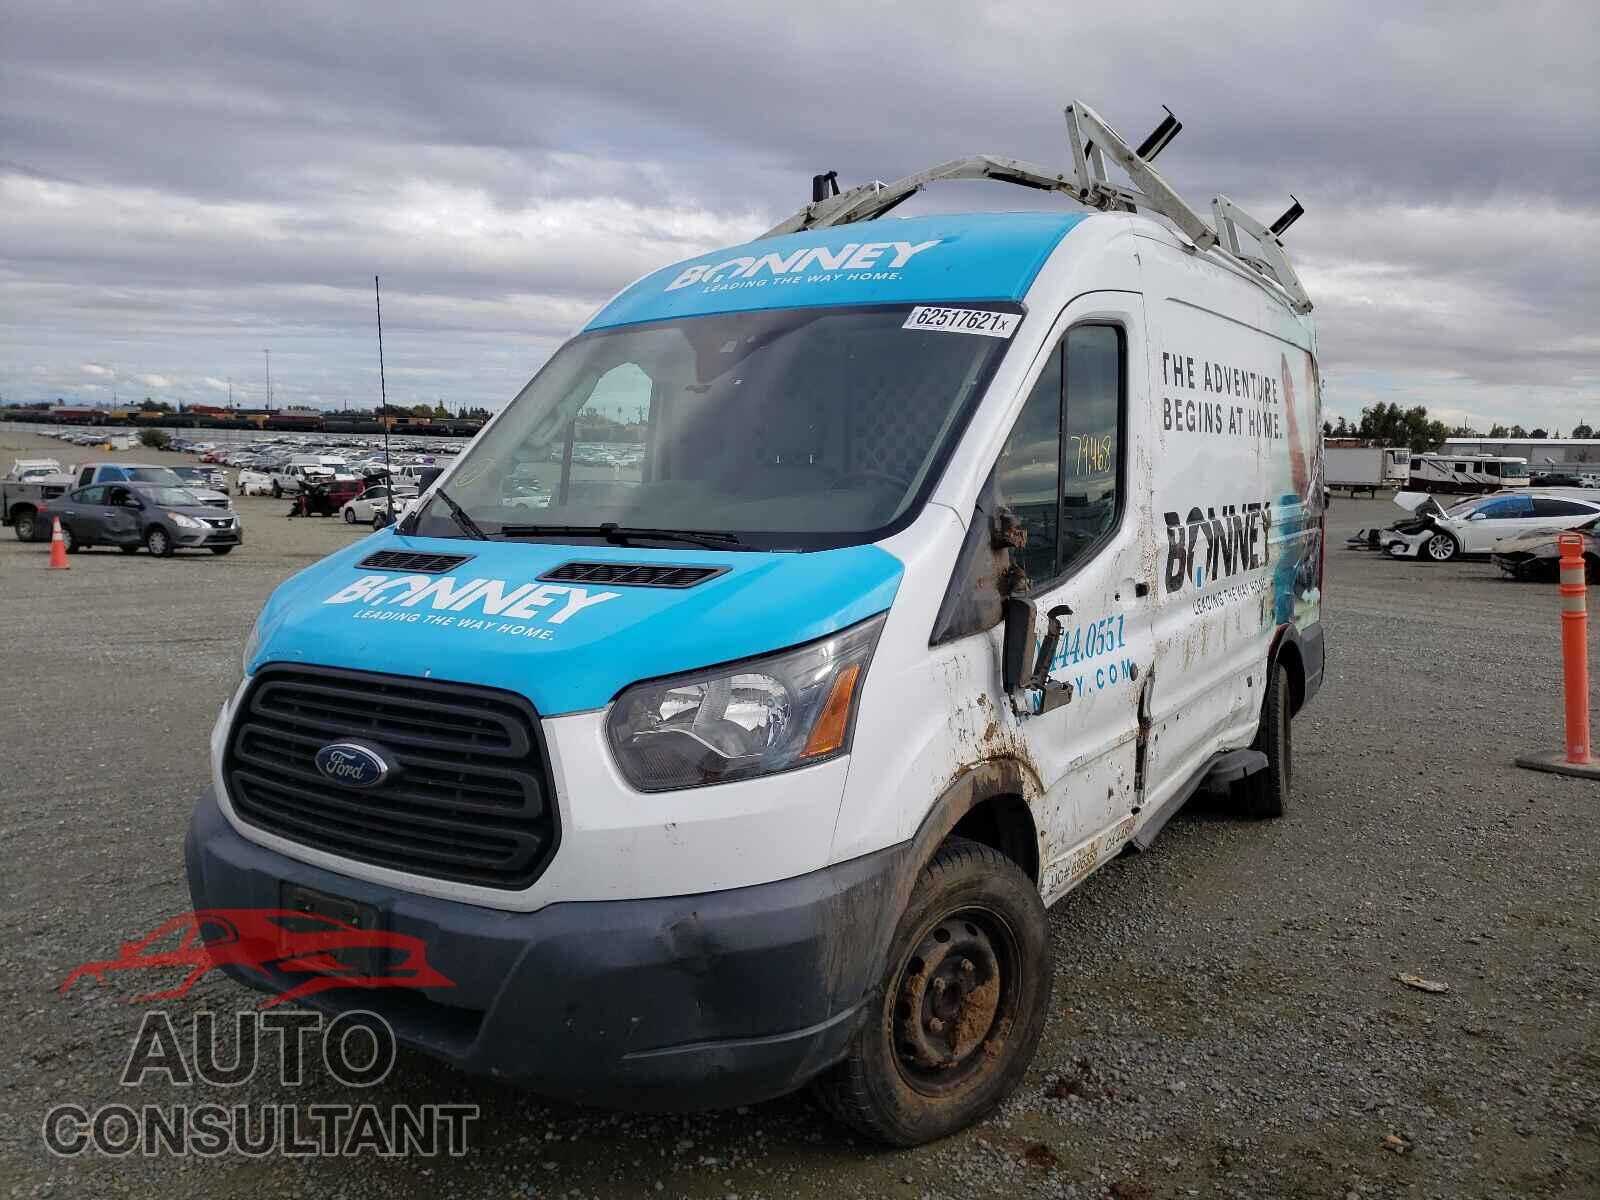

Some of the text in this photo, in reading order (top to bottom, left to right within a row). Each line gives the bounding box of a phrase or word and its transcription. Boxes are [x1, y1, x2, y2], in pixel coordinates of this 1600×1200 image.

[664, 240, 943, 291] BONNEY
[703, 271, 903, 293] LEADING THE WAY HOME.
[1162, 351, 1278, 405] THE ADVENTURE
[1163, 397, 1282, 440] BEGINS AT HOME.
[1163, 501, 1272, 594] BONNEY
[322, 574, 623, 625] BONNEY
[1192, 591, 1224, 615] LEADING
[353, 608, 554, 641] LEADING THE WAY HOME.
[326, 750, 366, 780] Ford
